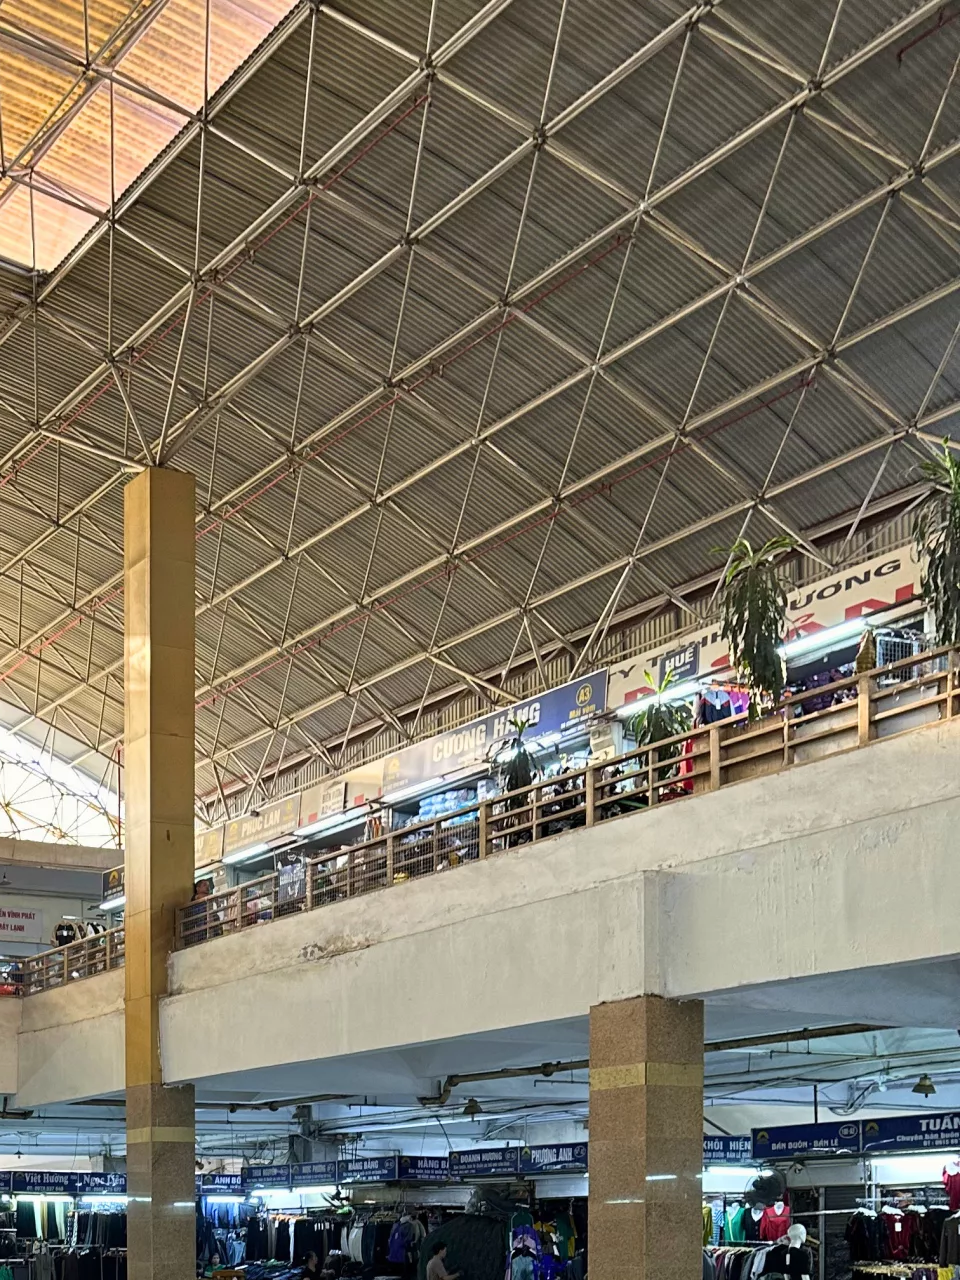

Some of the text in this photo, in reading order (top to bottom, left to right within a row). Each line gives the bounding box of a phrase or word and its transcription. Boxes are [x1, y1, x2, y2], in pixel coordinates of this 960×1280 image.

[578, 689, 590, 704] A3
[21, 911, 35, 920] PHÁT
[897, 1133, 922, 1142] Chuyên
[771, 1141, 787, 1150] BÁN
[788, 1140, 808, 1149] BUÔN
[813, 1138, 829, 1148] BÁN
[558, 1148, 573, 1161] ANH
[25, 1172, 41, 1183] Việt
